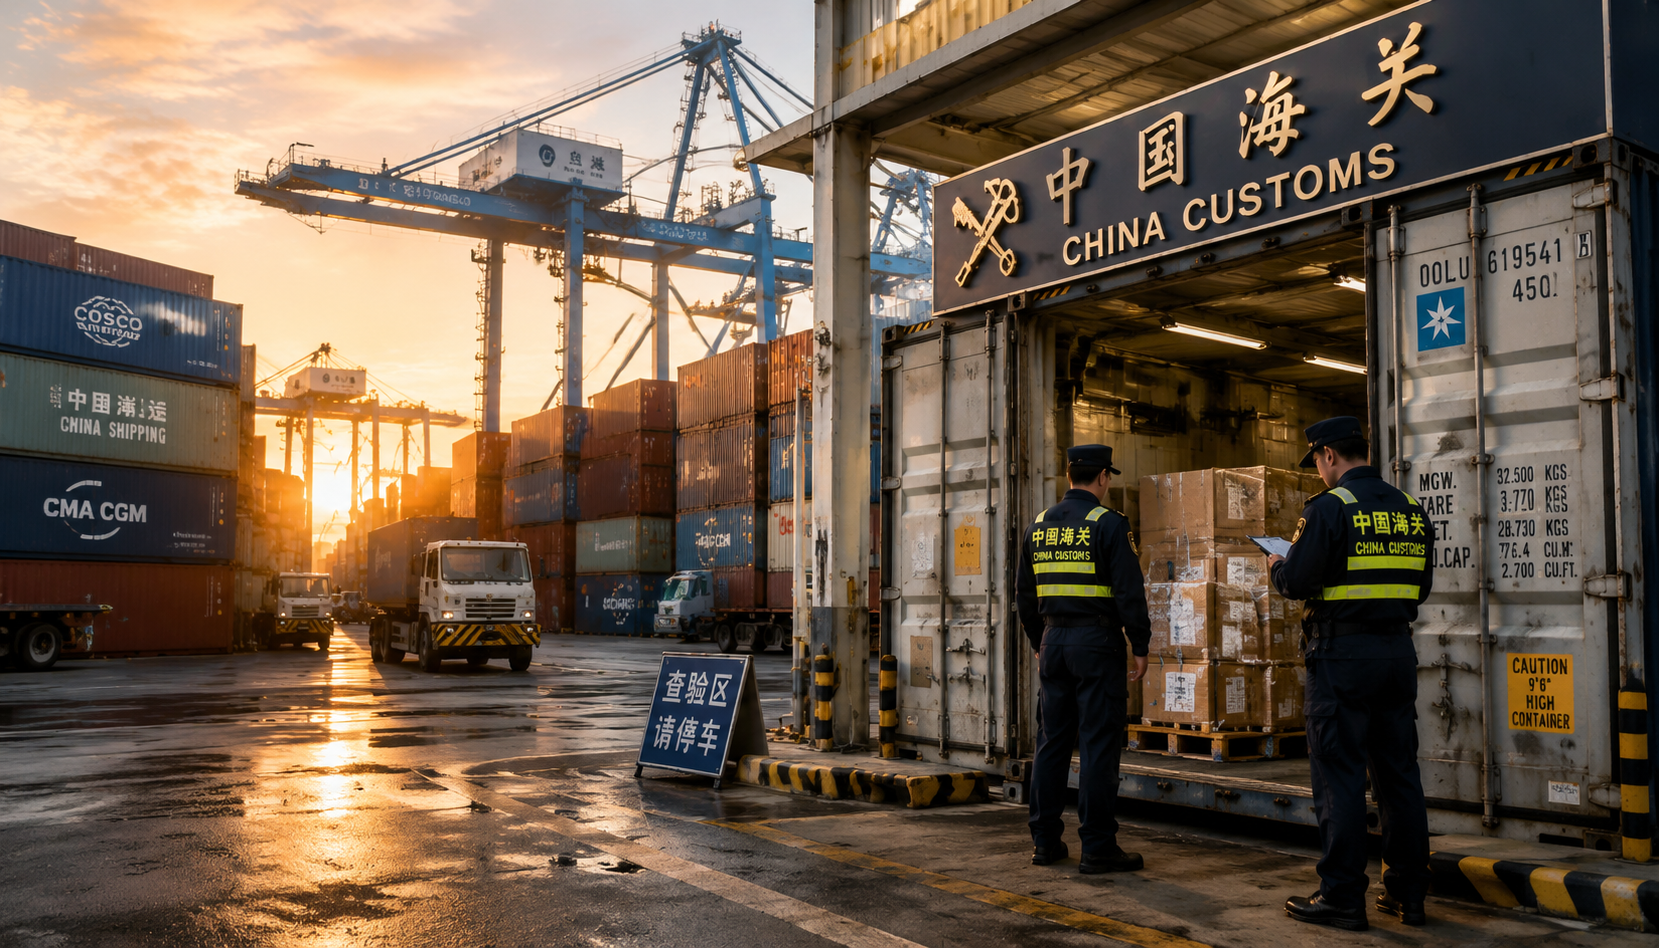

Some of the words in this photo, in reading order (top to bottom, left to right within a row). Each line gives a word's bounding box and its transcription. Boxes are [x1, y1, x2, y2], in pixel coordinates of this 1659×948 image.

[1046, 22, 1437, 225] 中国海关
[1062, 211, 1166, 266] CHINA
[1182, 143, 1396, 232] CUSTOMS
[1488, 238, 1561, 274] 619541
[74, 306, 143, 331] COSCO
[60, 416, 101, 436] CHINA
[109, 421, 166, 444] SHIPPING
[1420, 472, 1457, 491] MGW.
[1497, 466, 1534, 485] 32.500
[1545, 463, 1567, 481] KGS
[43, 498, 95, 519] CMA
[100, 501, 147, 523] CGM
[1419, 495, 1453, 515] TARE
[1432, 520, 1452, 541] ET.
[1498, 519, 1535, 537] 28.730
[1546, 519, 1569, 536] KGS
[1355, 541, 1385, 555] CHINA
[1502, 562, 1534, 578] 2.700
[1512, 657, 1568, 674] CAUTION
[662, 669, 732, 707] 查验区
[1526, 695, 1554, 710] HIGH
[1512, 711, 1570, 729] CONTAINER
